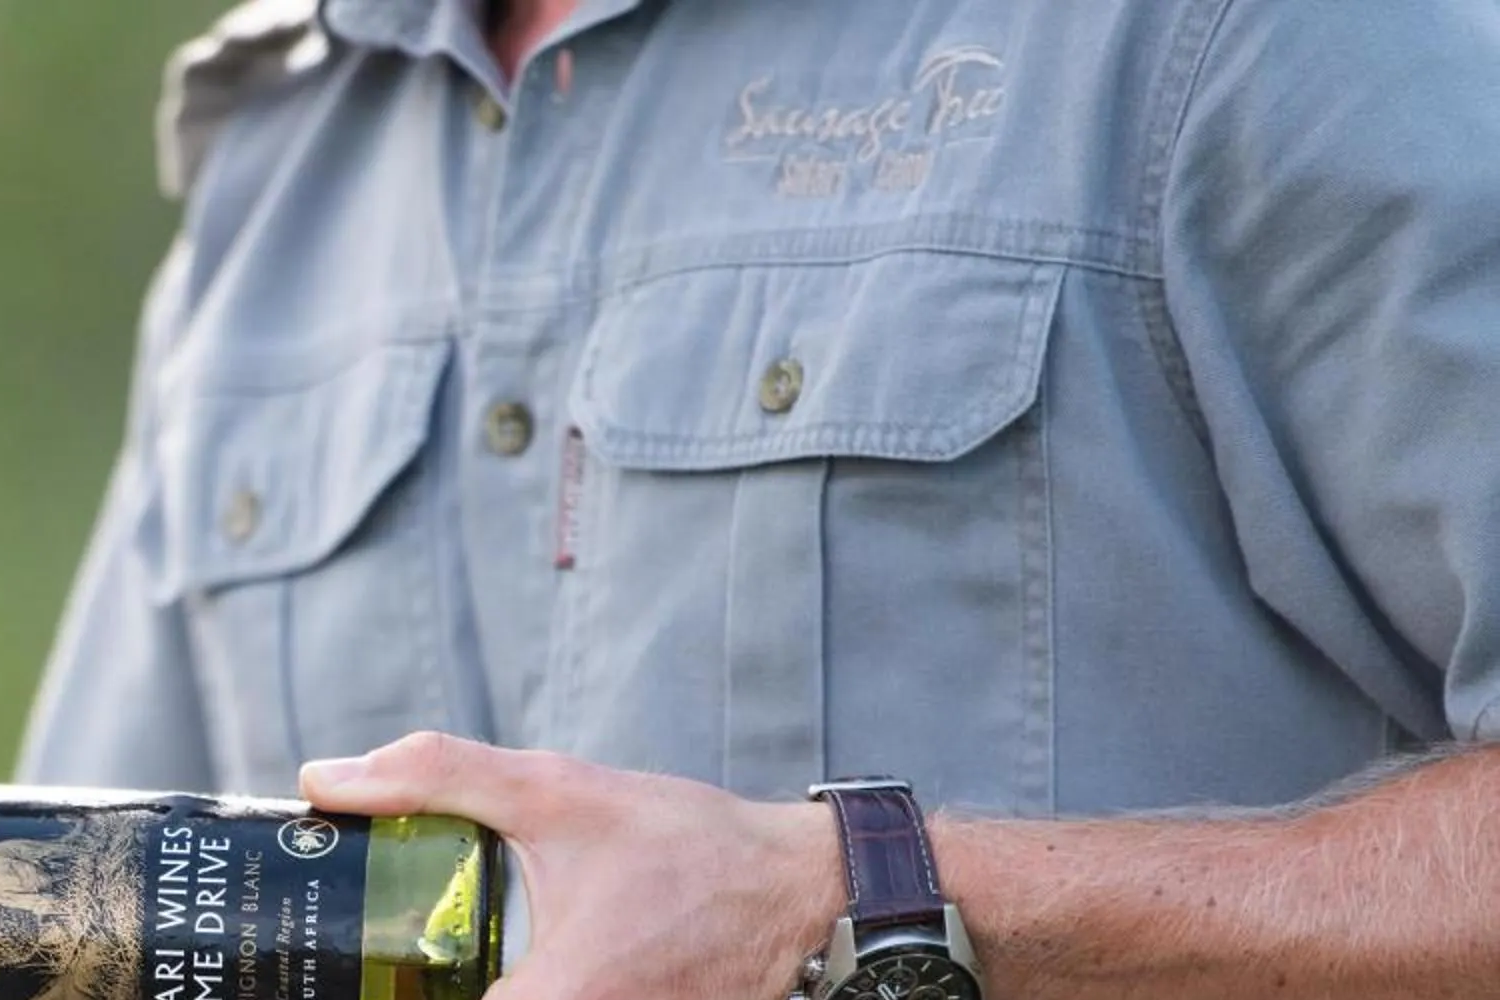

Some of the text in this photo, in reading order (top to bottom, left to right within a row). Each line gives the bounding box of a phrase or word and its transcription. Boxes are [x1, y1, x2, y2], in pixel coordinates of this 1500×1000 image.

[156, 825, 192, 928] WINES
[195, 837, 231, 934] DRIVE
[240, 849, 263, 912] BLANC
[276, 897, 295, 945] Region
[304, 879, 320, 951] AFRICA
